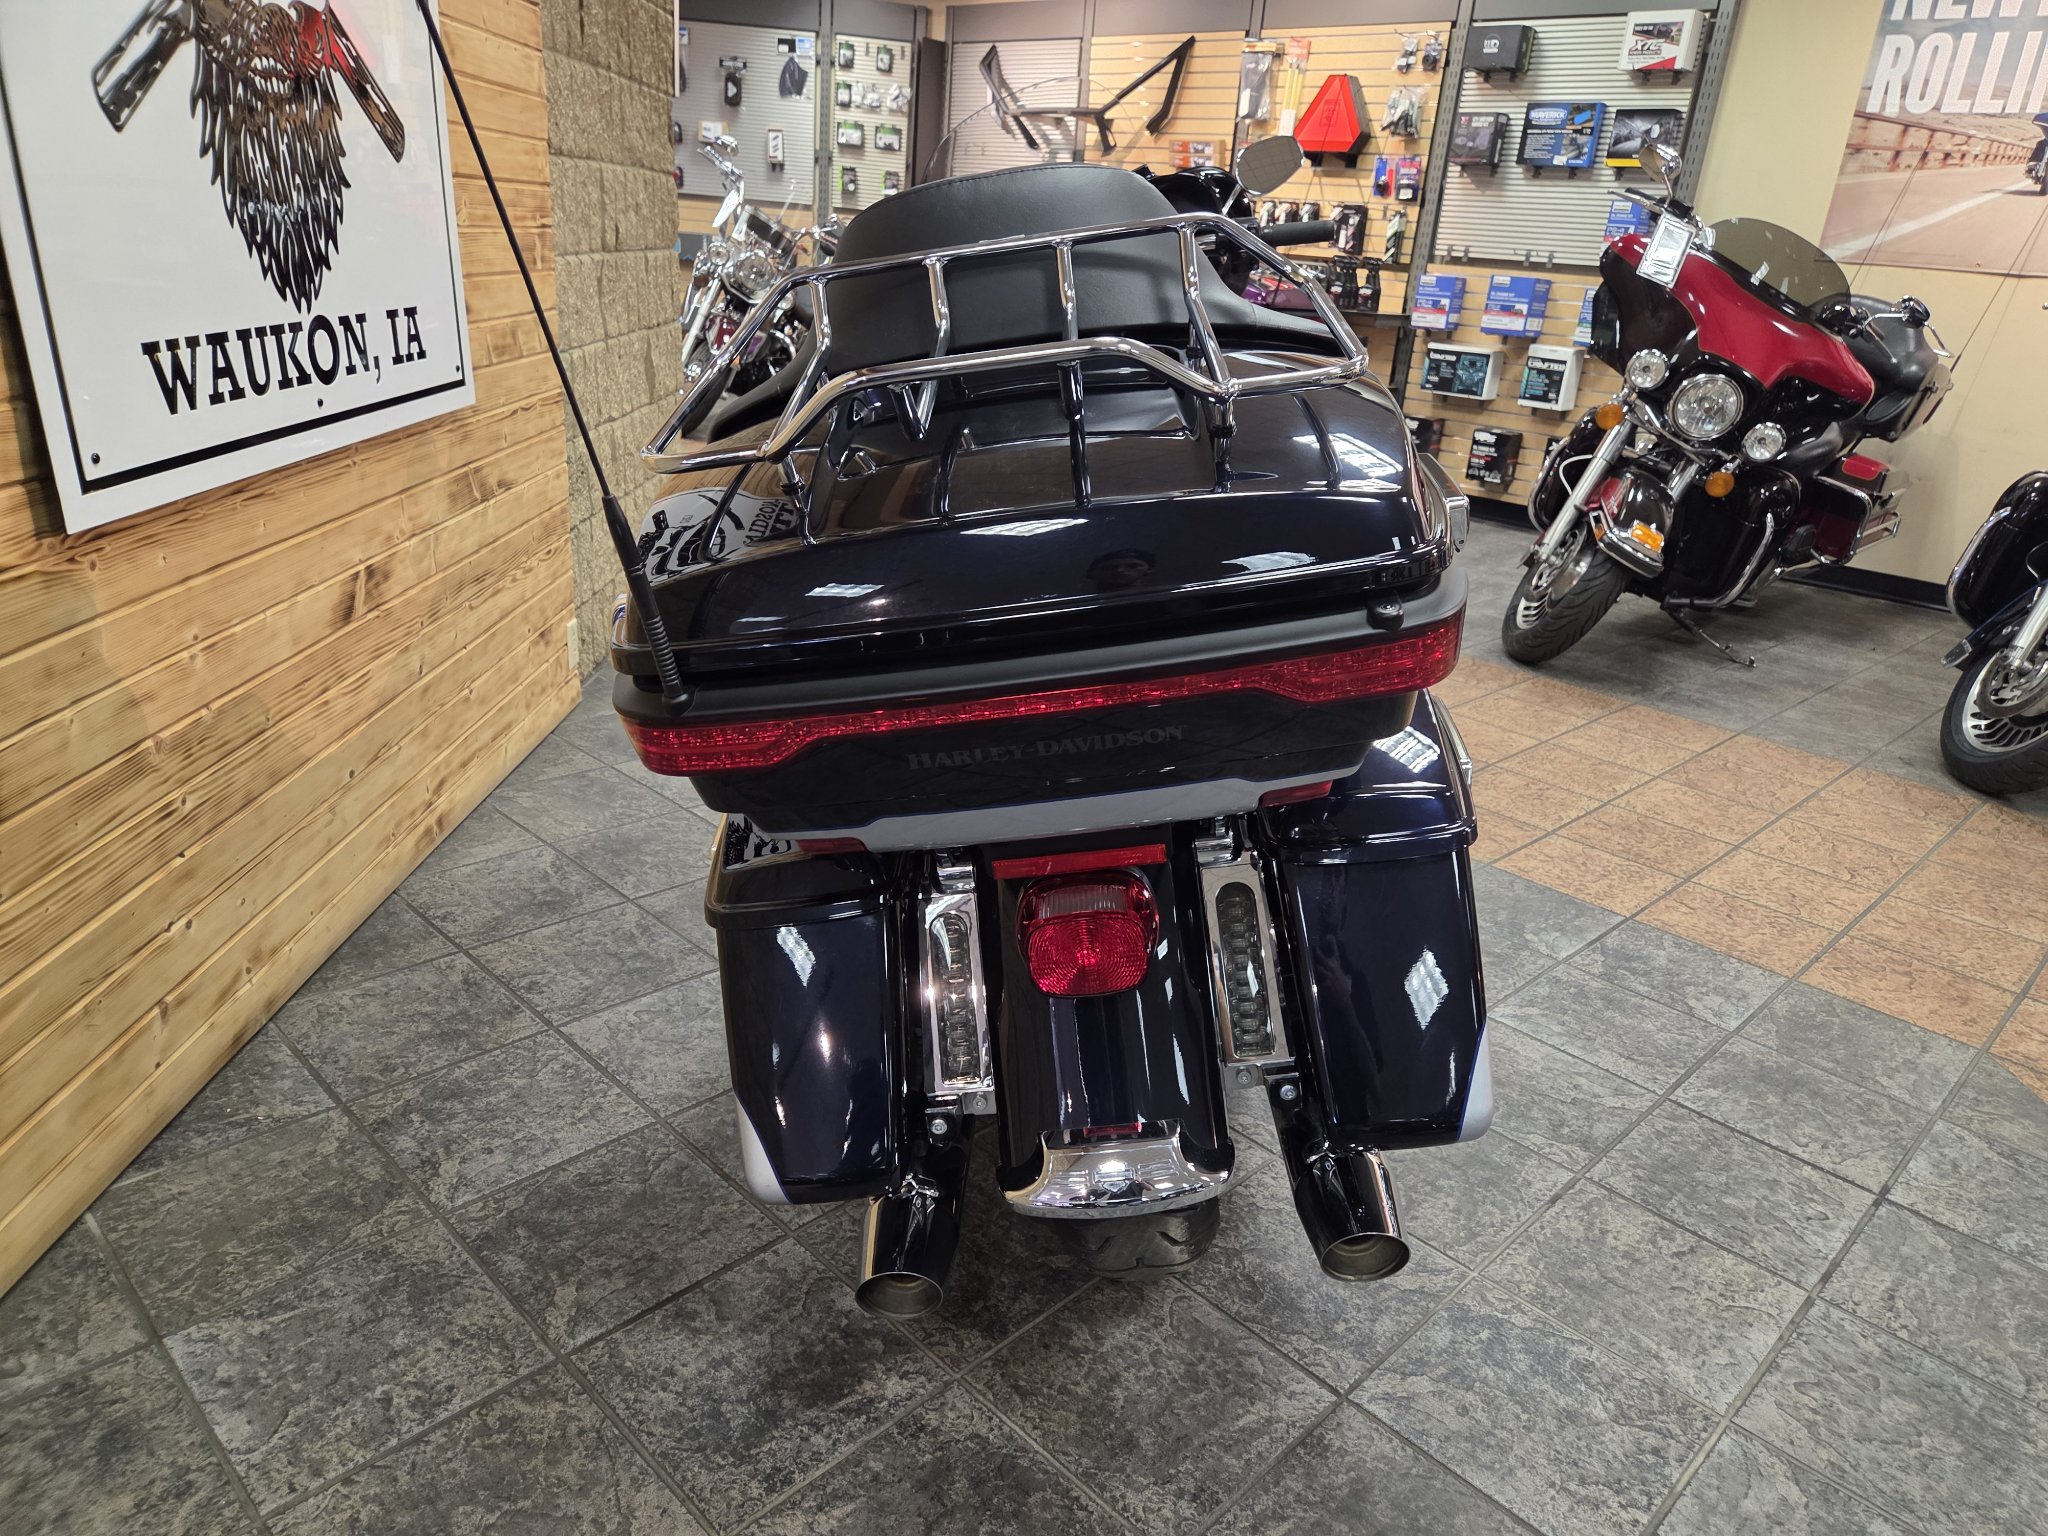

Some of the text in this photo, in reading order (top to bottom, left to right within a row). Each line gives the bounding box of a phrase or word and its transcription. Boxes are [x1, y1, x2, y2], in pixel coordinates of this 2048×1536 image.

[140, 306, 427, 415] WAUKON, IA
[906, 726, 1184, 770] HARLEY-DAVIDSON
